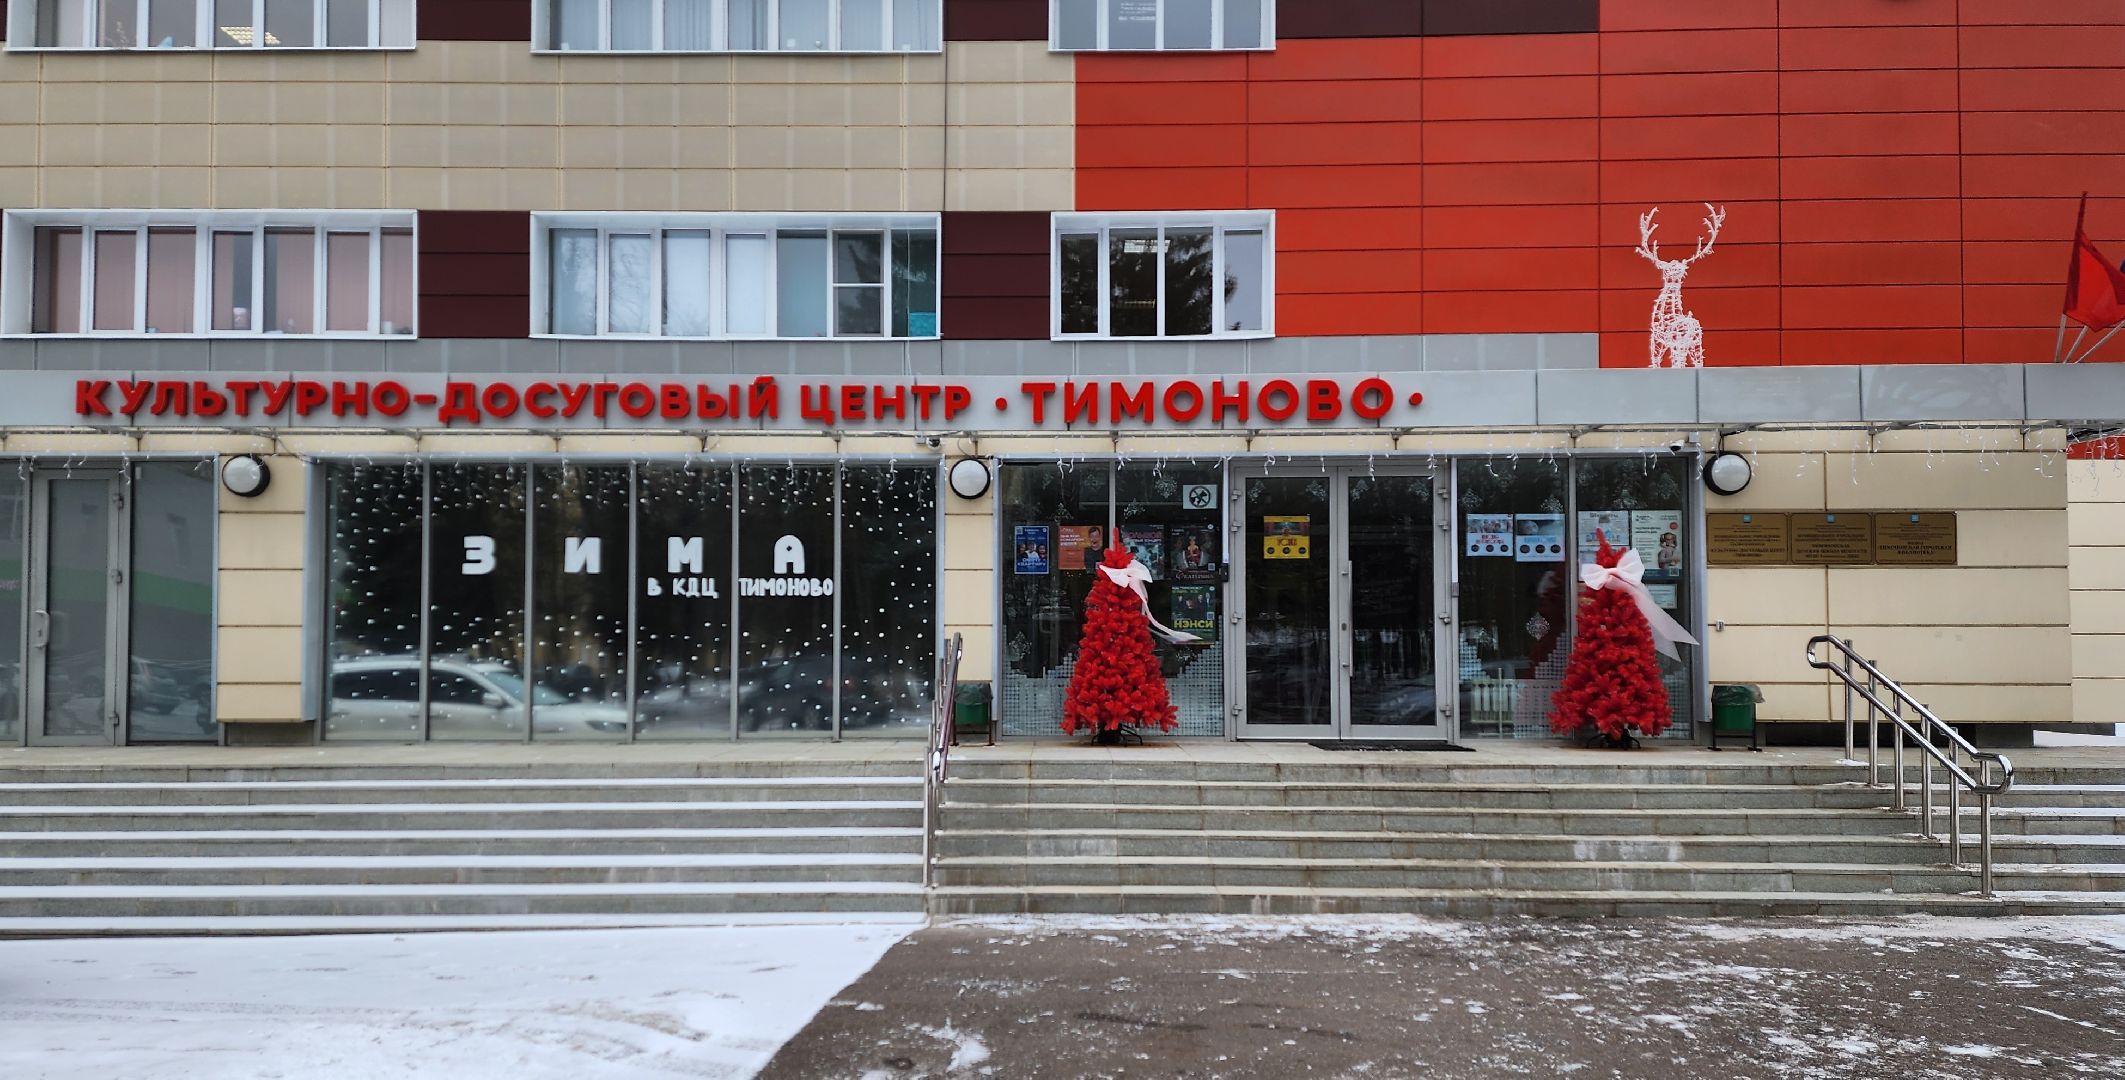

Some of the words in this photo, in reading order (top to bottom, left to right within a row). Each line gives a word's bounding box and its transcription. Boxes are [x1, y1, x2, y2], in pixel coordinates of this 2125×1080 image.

[75, 376, 778, 425] КУЛЬТУРНО-ДОСУГОВЫЙ
[800, 384, 972, 426] ЦЕНТР
[1021, 377, 1394, 424] ТИМОНОВО
[646, 577, 663, 597] В
[672, 577, 720, 600] КДЦ
[738, 576, 834, 597] ТИМОНОВО
[1173, 619, 1214, 628] НЭНСИ
